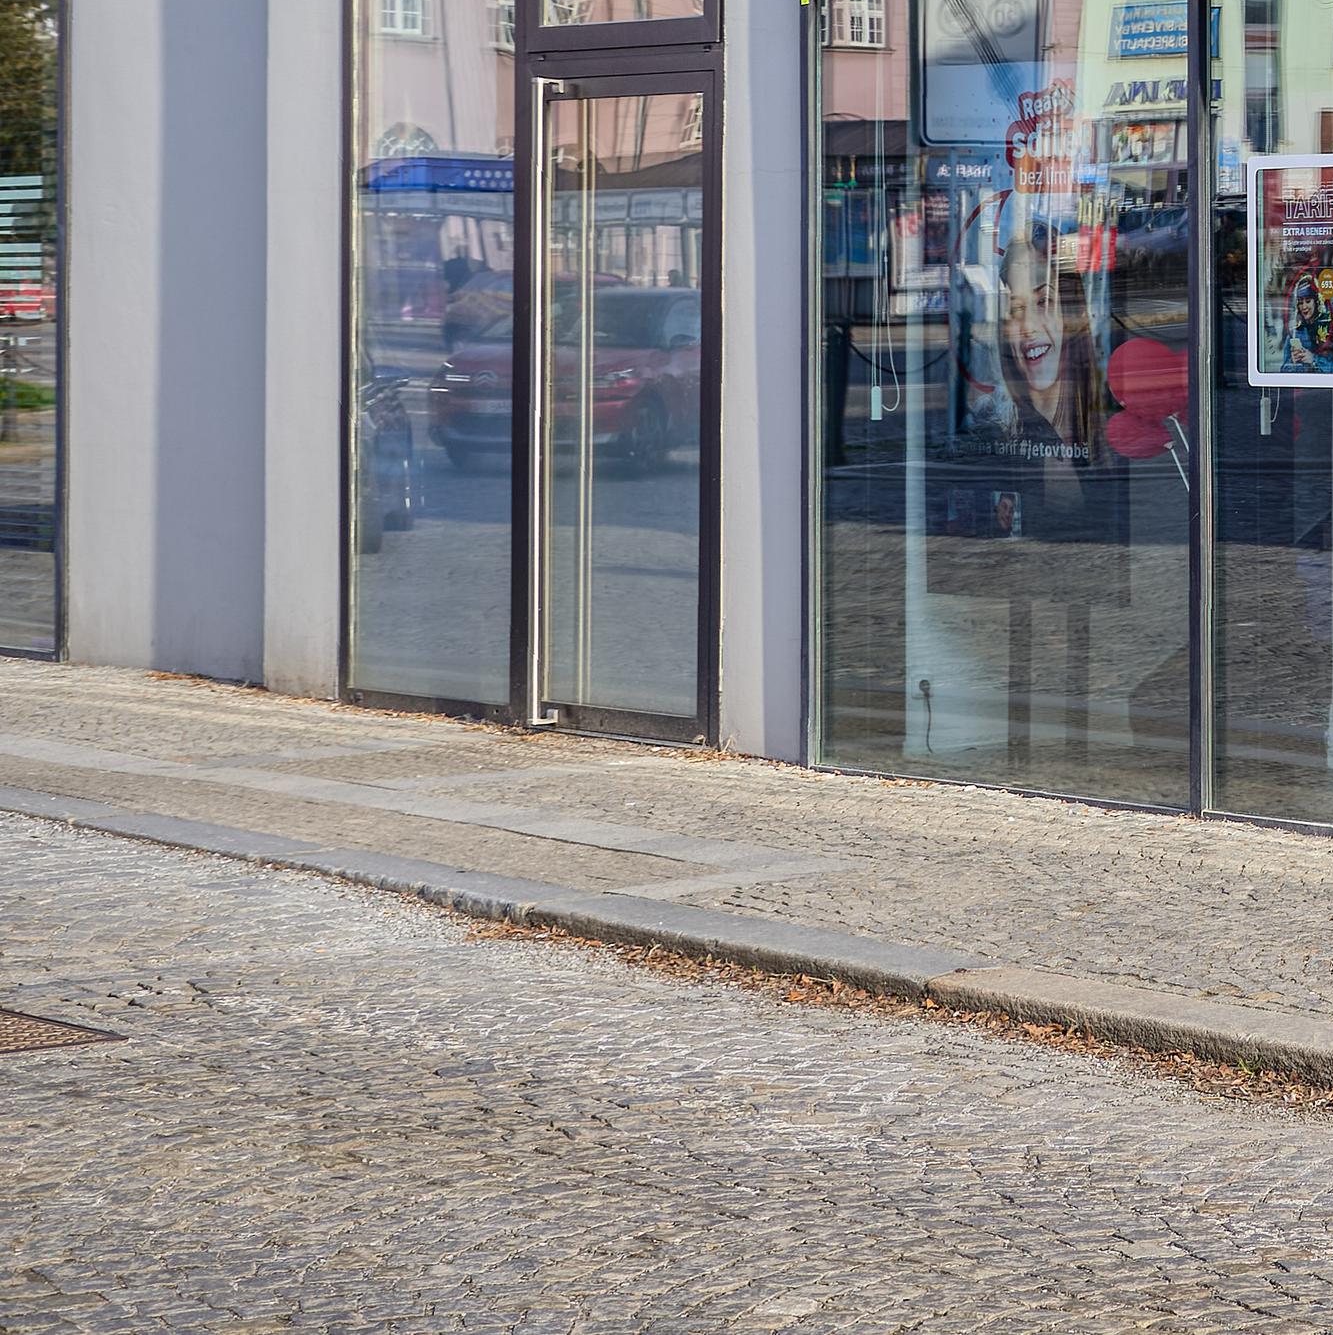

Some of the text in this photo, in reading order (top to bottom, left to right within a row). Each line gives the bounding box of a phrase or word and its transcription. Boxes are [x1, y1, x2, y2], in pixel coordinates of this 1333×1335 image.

[1019, 167, 1042, 185] bez
[1283, 227, 1305, 237] EXTRA
[1019, 439, 1090, 460] #jetovtobě
